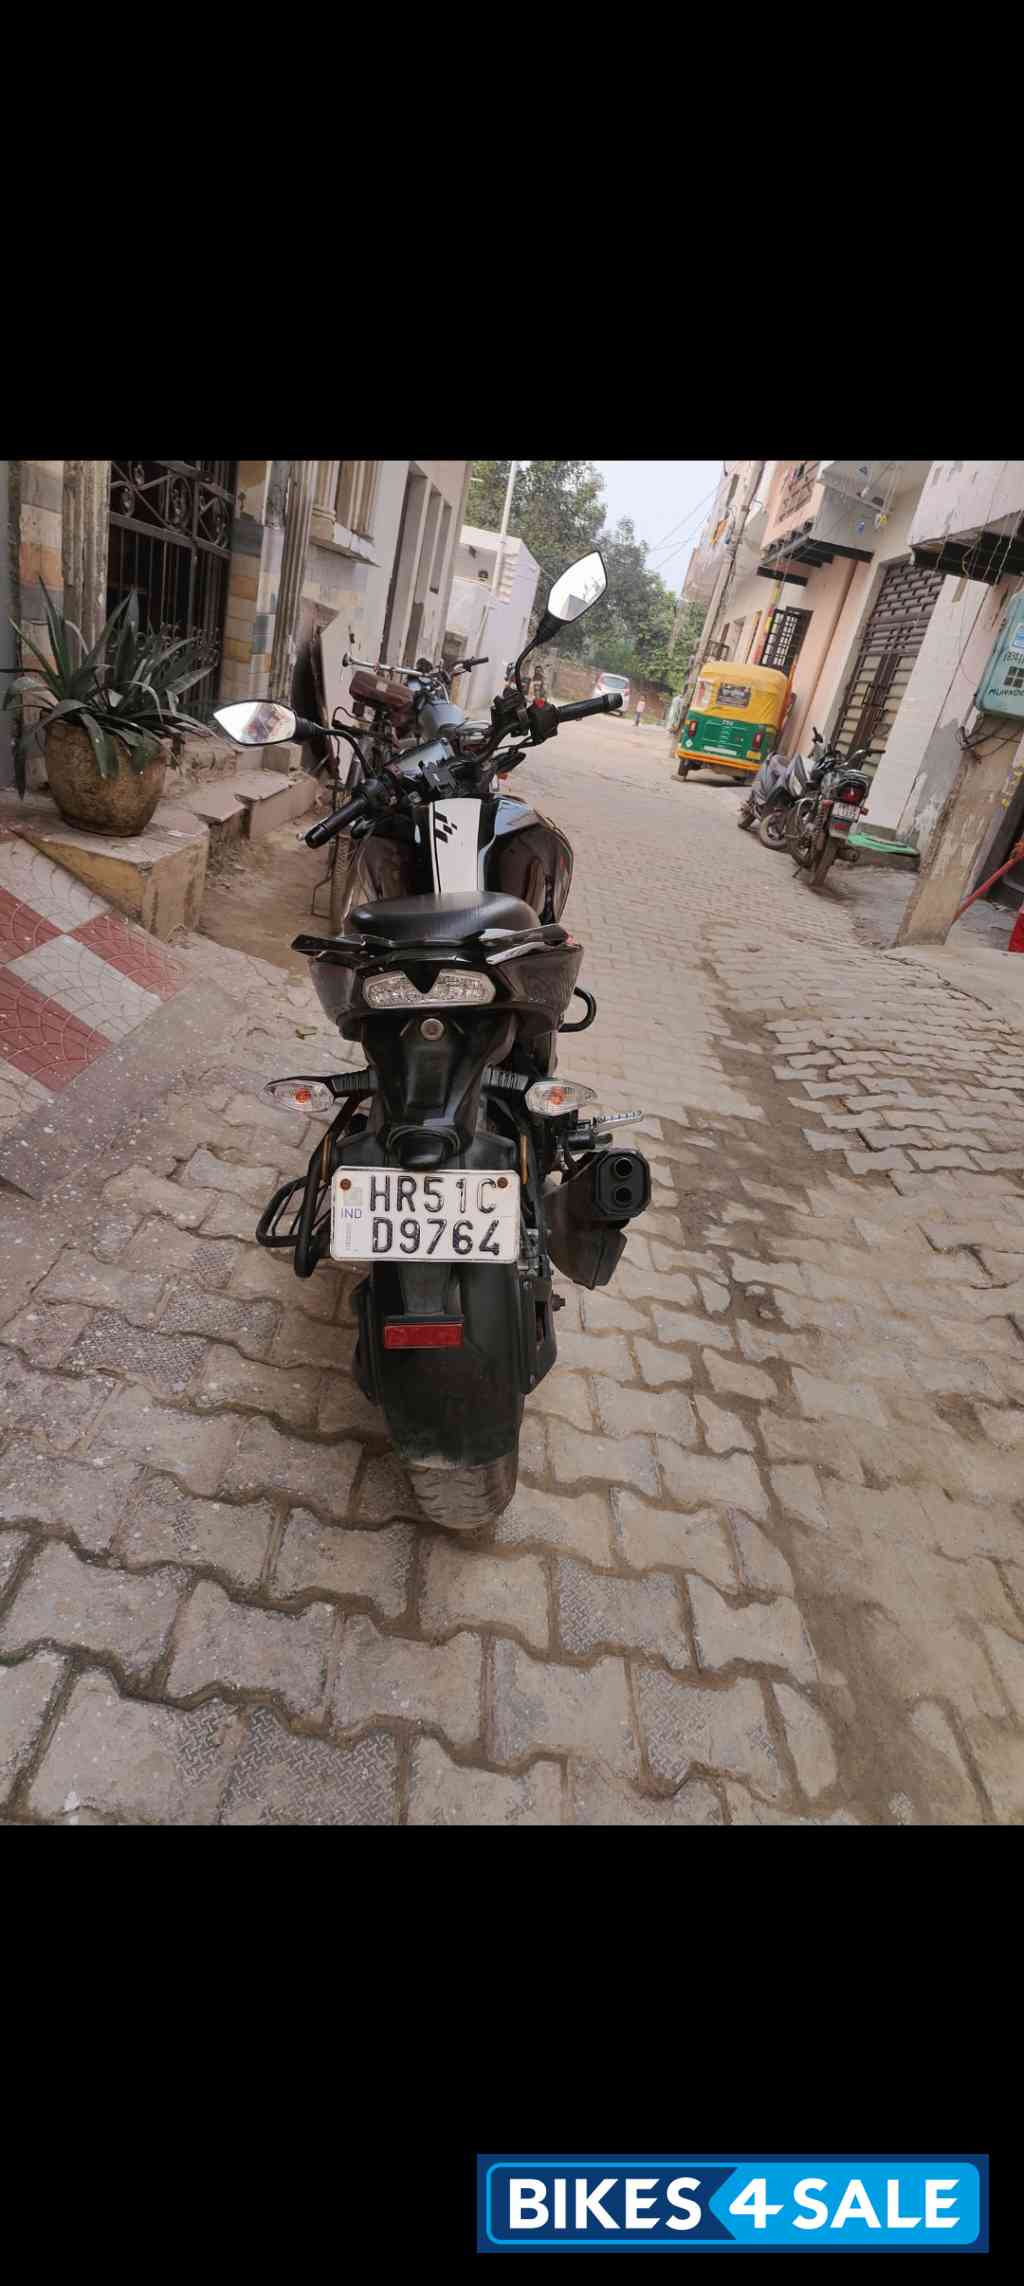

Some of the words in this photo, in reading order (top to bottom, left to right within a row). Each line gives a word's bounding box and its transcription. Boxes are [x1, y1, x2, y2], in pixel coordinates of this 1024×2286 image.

[340, 1208, 362, 1219] IND
[370, 1175, 497, 1214] HR51C
[372, 1217, 500, 1255] D9764
